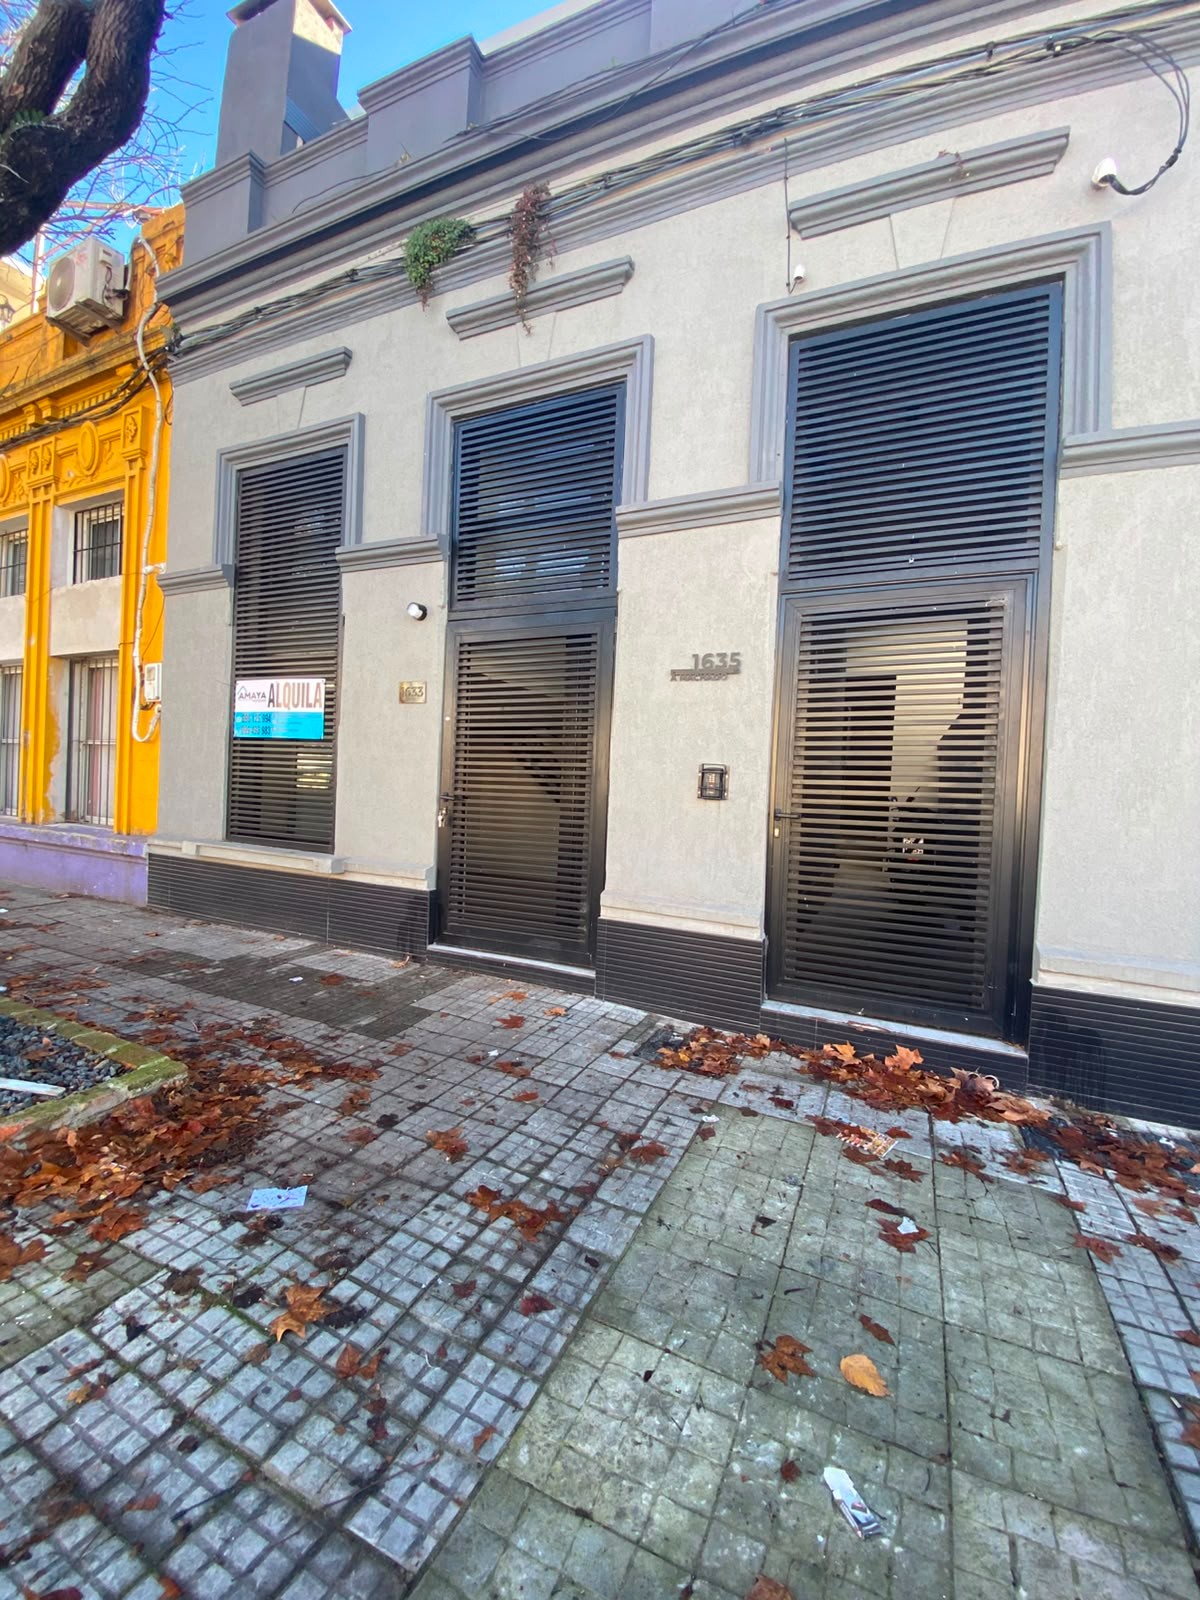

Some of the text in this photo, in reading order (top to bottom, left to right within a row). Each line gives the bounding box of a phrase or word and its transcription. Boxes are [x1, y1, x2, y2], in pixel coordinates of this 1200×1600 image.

[692, 652, 741, 669] 1635
[238, 691, 267, 699] AMAYA
[267, 682, 323, 710] ALQUILA
